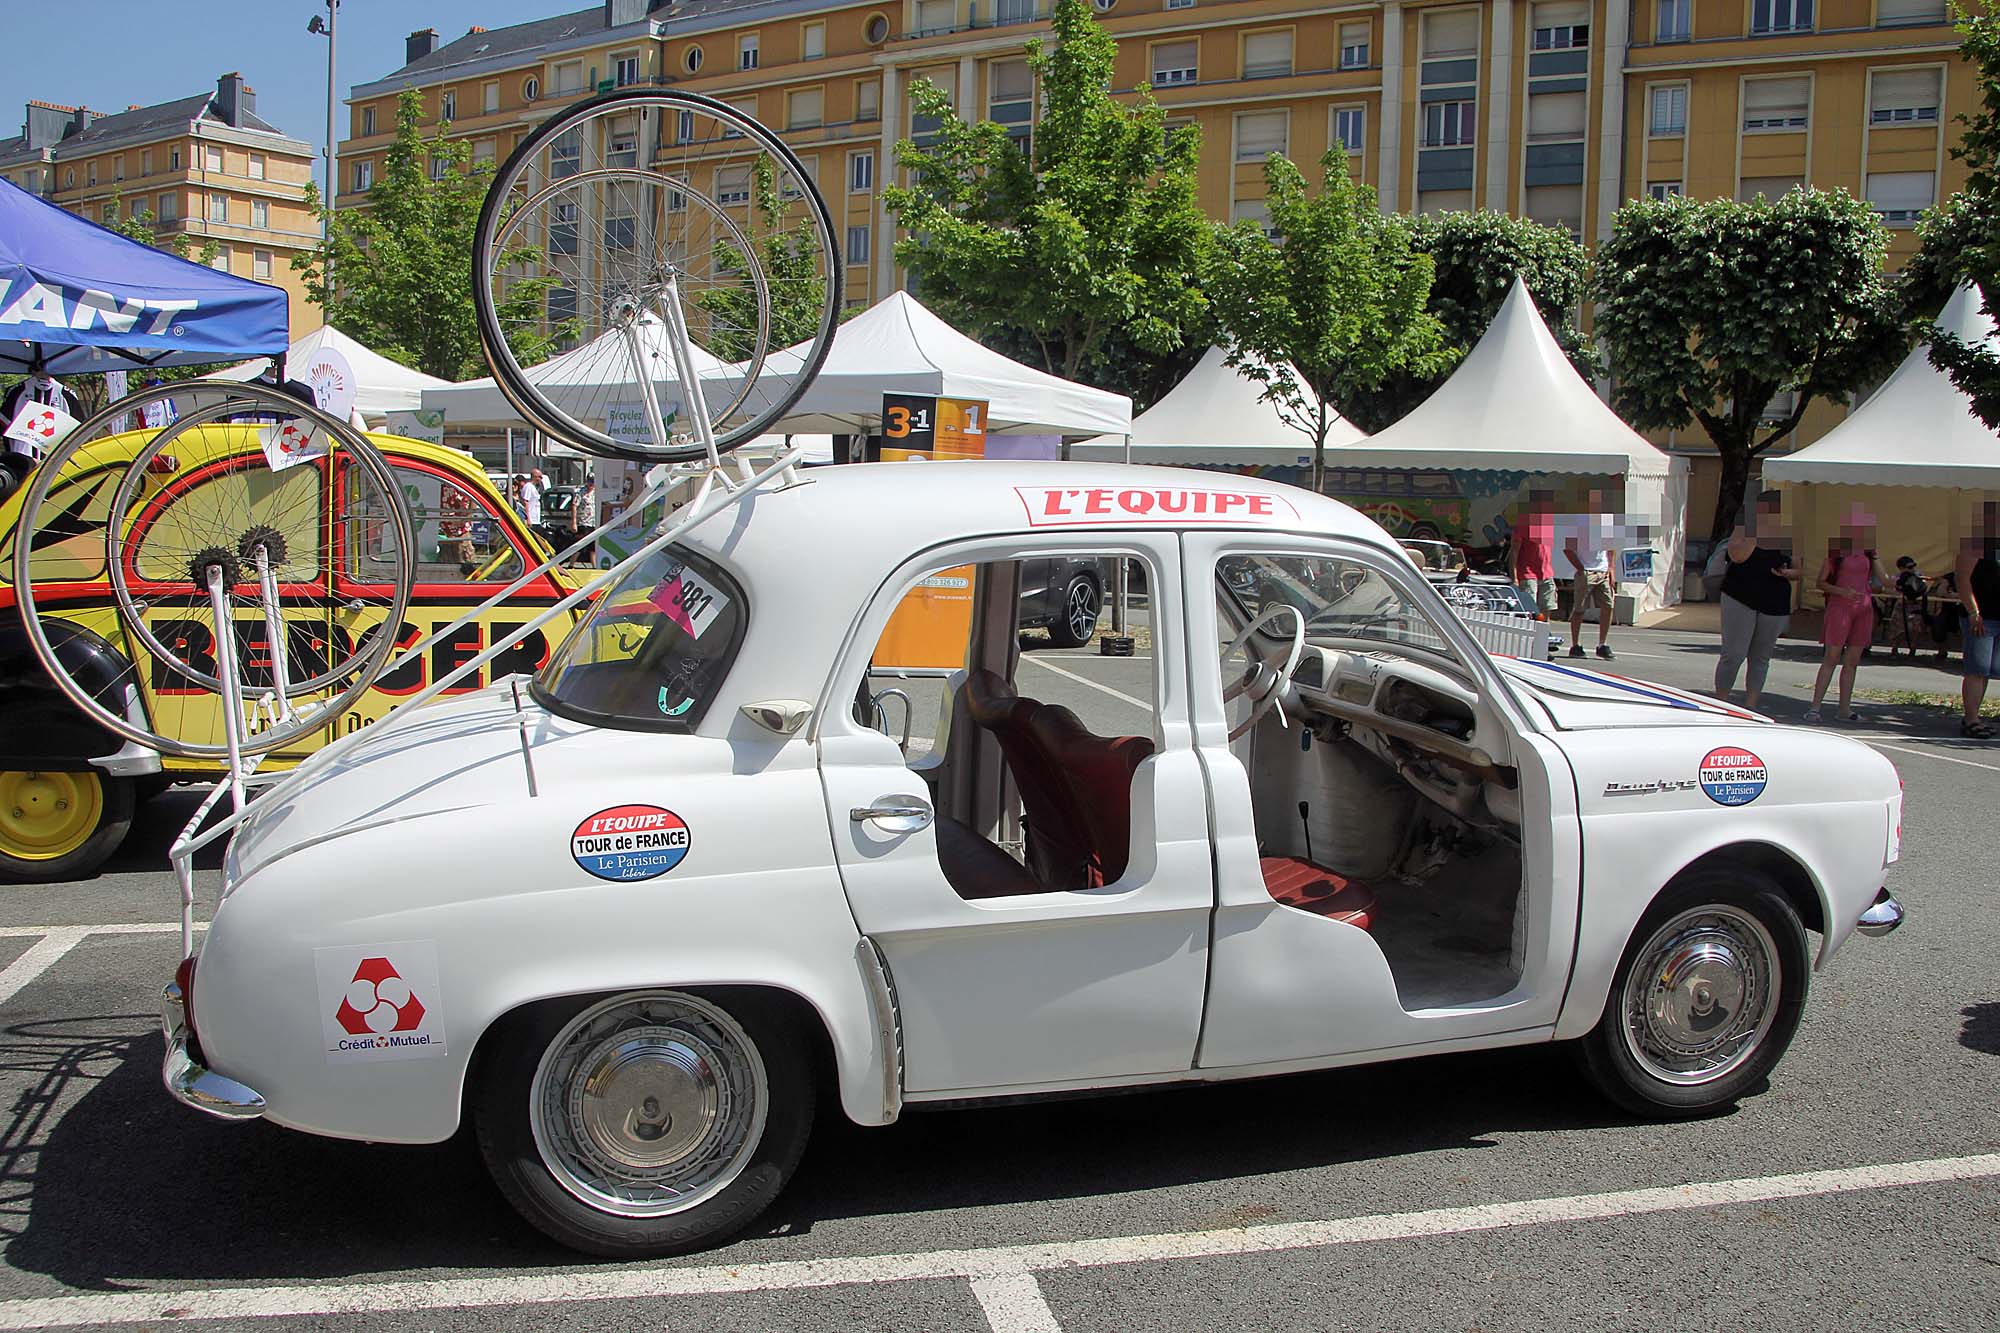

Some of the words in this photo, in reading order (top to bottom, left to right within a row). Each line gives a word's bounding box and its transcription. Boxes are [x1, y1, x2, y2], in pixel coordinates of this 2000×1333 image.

[0, 279, 199, 336] ANT
[963, 405, 982, 435] 1
[672, 580, 713, 621] 981
[151, 618, 552, 697] BERGER
[1702, 771, 1723, 783] TOUR
[1725, 770, 1735, 782] de
[1736, 769, 1765, 781] FRANCE
[1715, 785, 1724, 796] Le
[1726, 784, 1754, 795] Parisien
[577, 838, 612, 854] TOUR
[615, 836, 632, 850] de
[636, 831, 685, 849] FRANCE
[599, 857, 614, 870] Le
[617, 853, 667, 868] Parisien
[339, 1039, 375, 1051] Crédit
[389, 1034, 431, 1047] Mutuel
